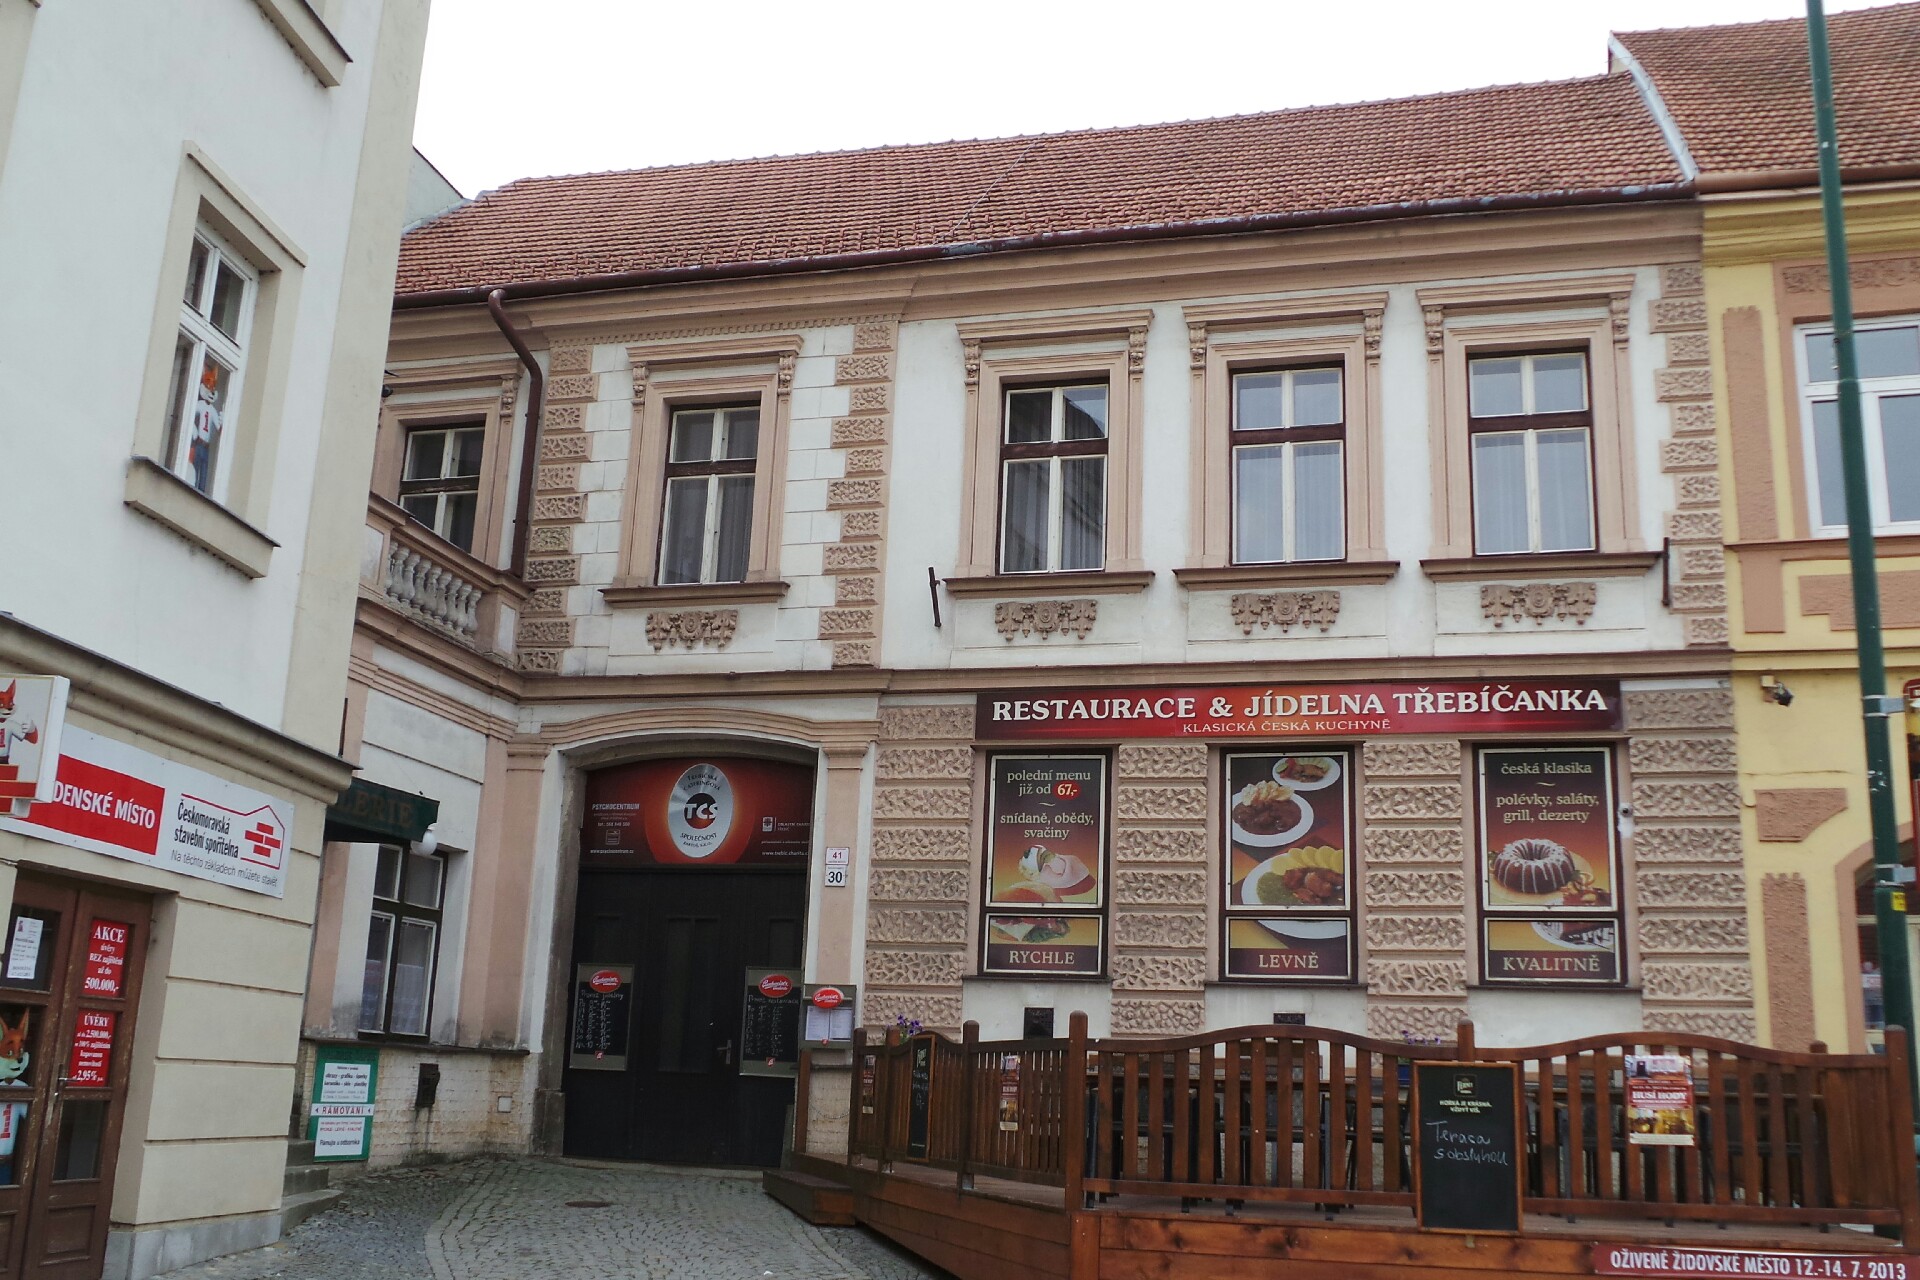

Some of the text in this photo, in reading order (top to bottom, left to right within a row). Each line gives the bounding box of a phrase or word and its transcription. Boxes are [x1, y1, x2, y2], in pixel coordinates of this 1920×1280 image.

[991, 684, 1608, 721] RESTAURACE & JÍDELNA TŘEBÍČANKA
[1182, 718, 1391, 733] KLASICKÁ ČESKÁ KUCHYNĚ
[1006, 770, 1091, 783] polední menu
[1500, 762, 1592, 775] česká klasika
[1018, 782, 1078, 798] již od 67,-
[1496, 792, 1600, 808] polévky, saláty,
[114, 798, 156, 830] MÍSTO
[177, 798, 230, 835] Českomoravská
[684, 802, 718, 820] TCS
[1503, 809, 1590, 825] grill, dezerty
[1000, 812, 1094, 827] snídaně, obědy,
[1024, 826, 1070, 840] svačiny
[174, 825, 240, 859] stavební spořitelna
[171, 849, 182, 862] Na
[183, 852, 204, 868] těchto
[204, 859, 236, 877] základech
[237, 867, 261, 882] můžete
[828, 872, 842, 884] 30
[93, 925, 125, 943] AKCE
[100, 942, 116, 954] úvěry
[90, 952, 102, 962] BEZ
[1008, 950, 1076, 965] RYCHLE
[1258, 951, 1319, 970] LEVNĚ
[1502, 954, 1600, 972] KVALITNĚ
[105, 966, 112, 975] do
[84, 976, 120, 994] 500.000,-
[84, 1012, 110, 1027] ÚVĚRY
[77, 1070, 98, 1082] 2,95%
[1632, 1090, 1687, 1100] HUSÍ HODY
[1610, 1248, 1906, 1280] OŽIVENÉ ŽIDOVSKÉ MĚSTO 12.-14. 7. 2013
